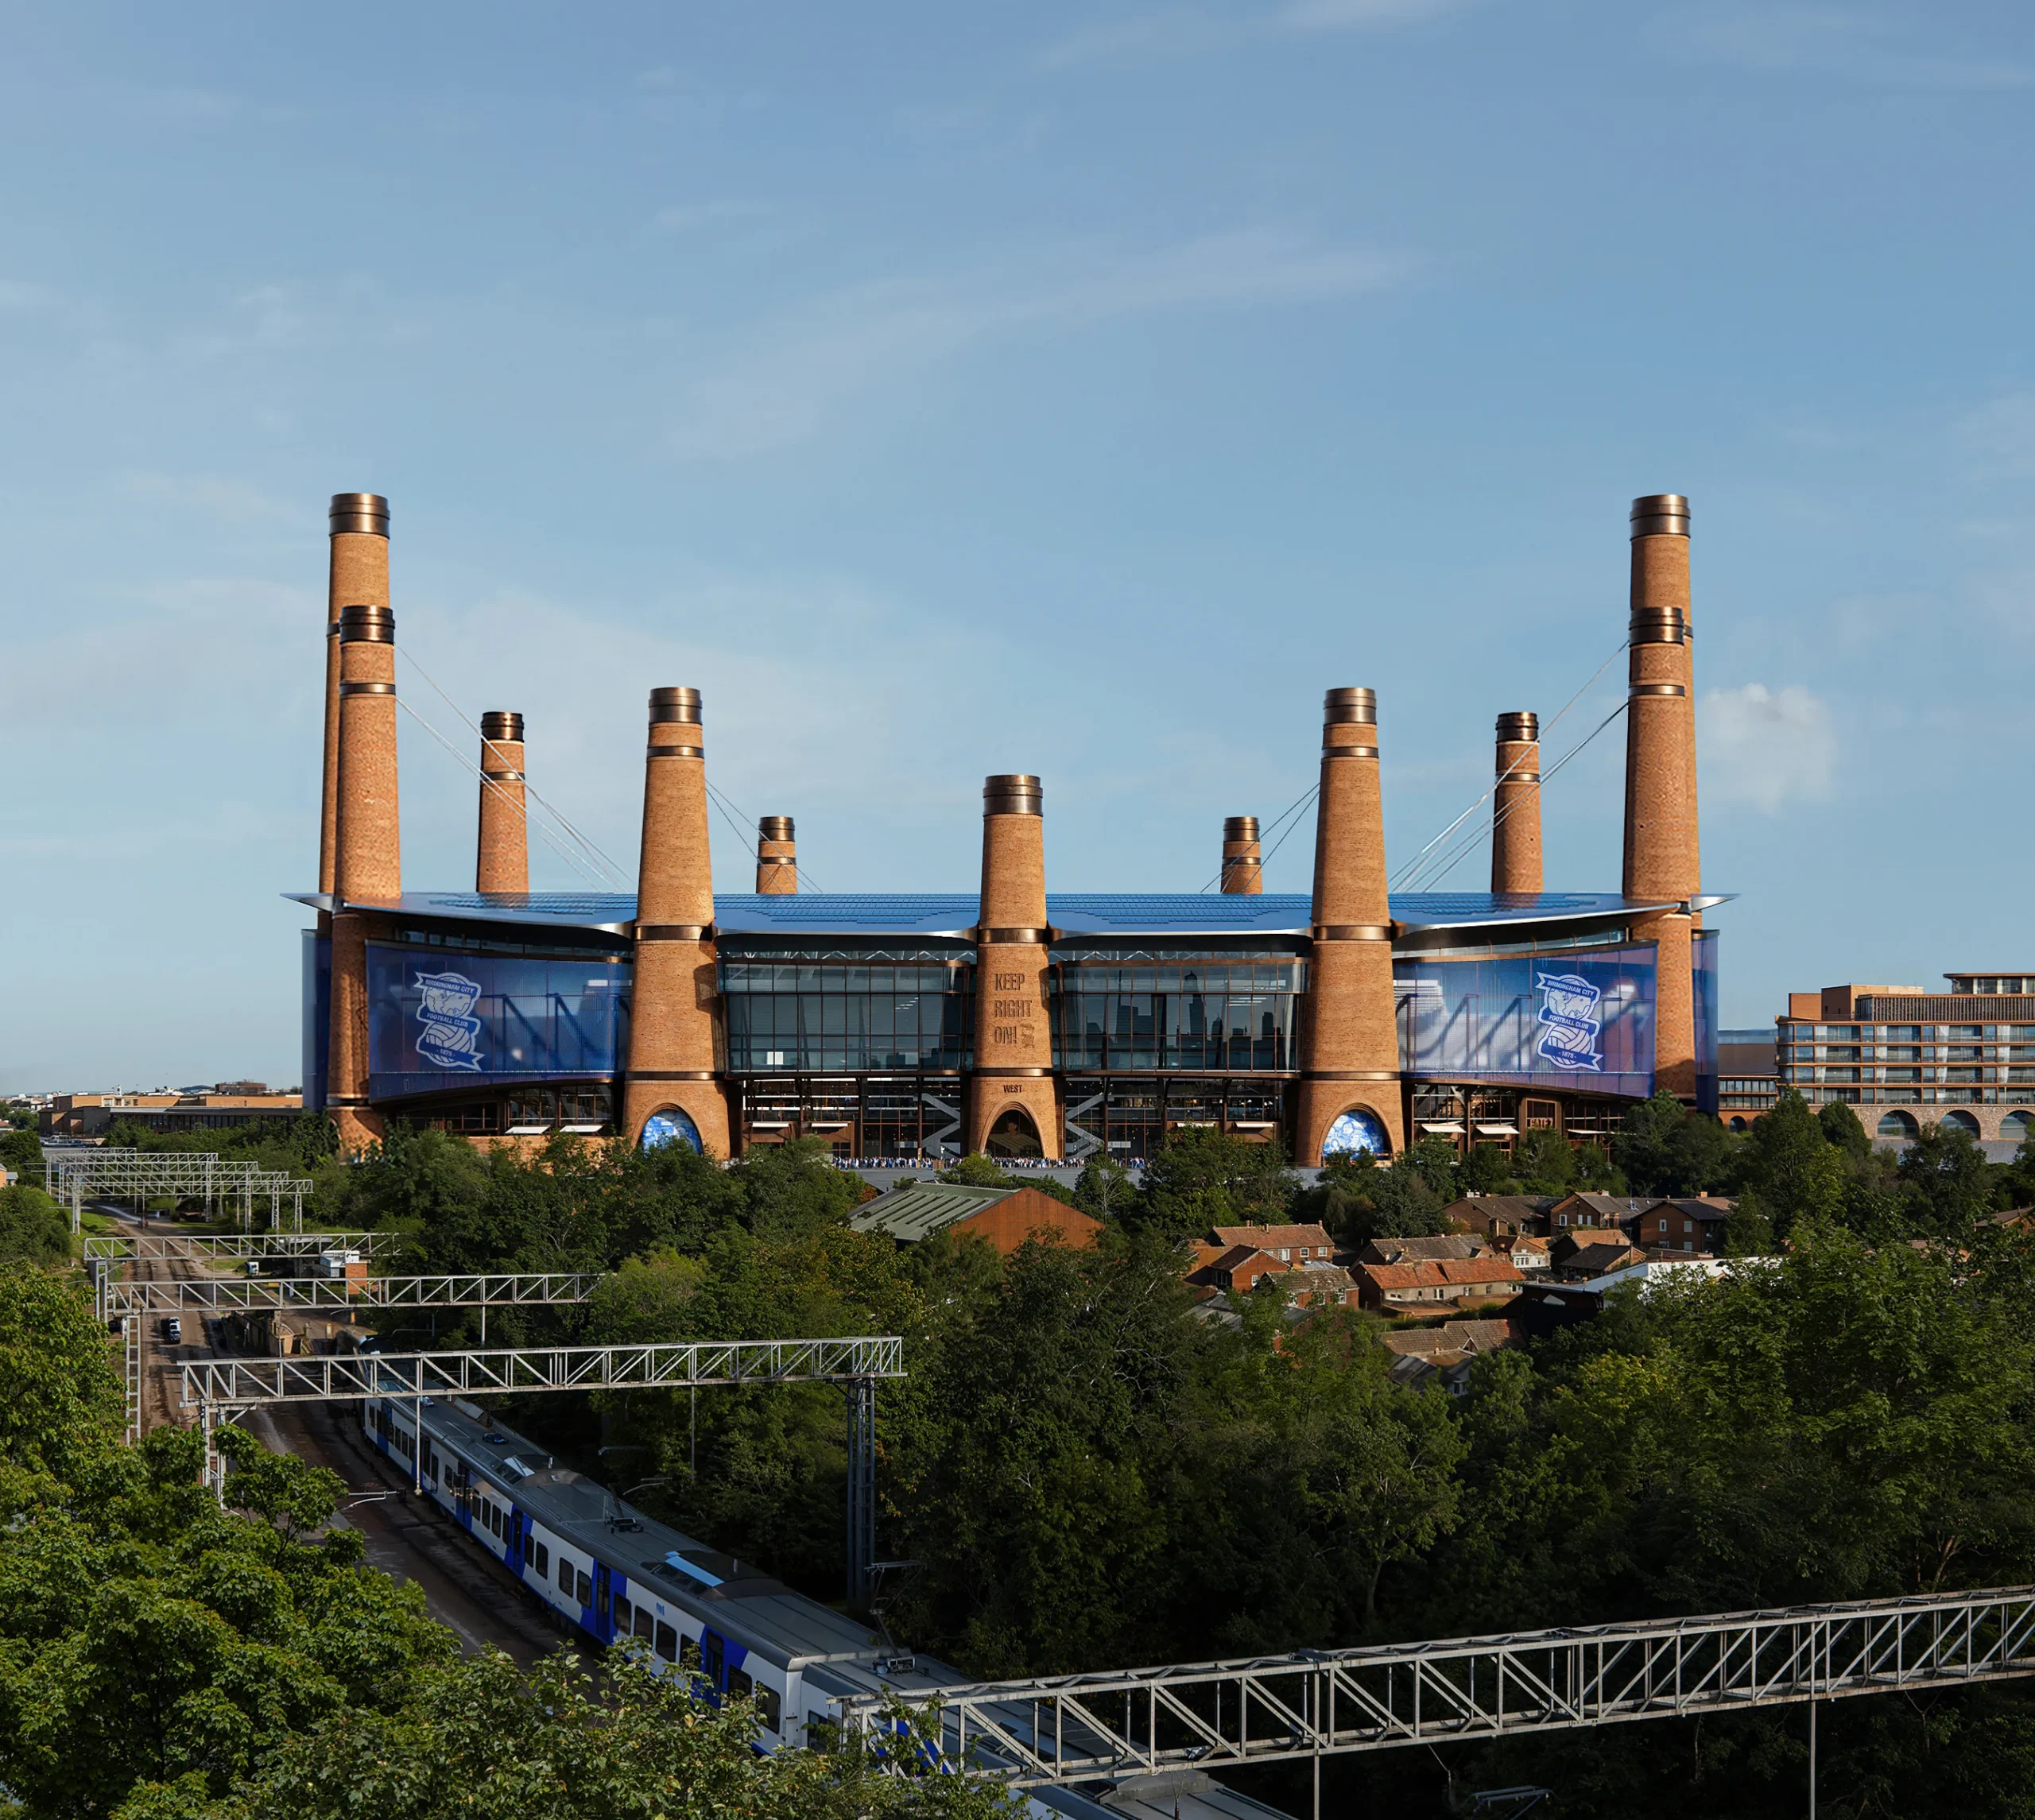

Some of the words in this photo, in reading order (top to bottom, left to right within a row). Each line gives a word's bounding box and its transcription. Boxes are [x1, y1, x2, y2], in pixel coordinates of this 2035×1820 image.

[425, 979, 460, 992] BIRMINGHAM
[994, 974, 1025, 991] KEEP
[1547, 980, 1581, 993] BIRMINGHAM
[994, 1000, 1032, 1017] RIGHT
[427, 1013, 453, 1024] FOOTBALL
[1549, 1015, 1575, 1026] FOOTBALL
[994, 1026, 1018, 1044] ON!
